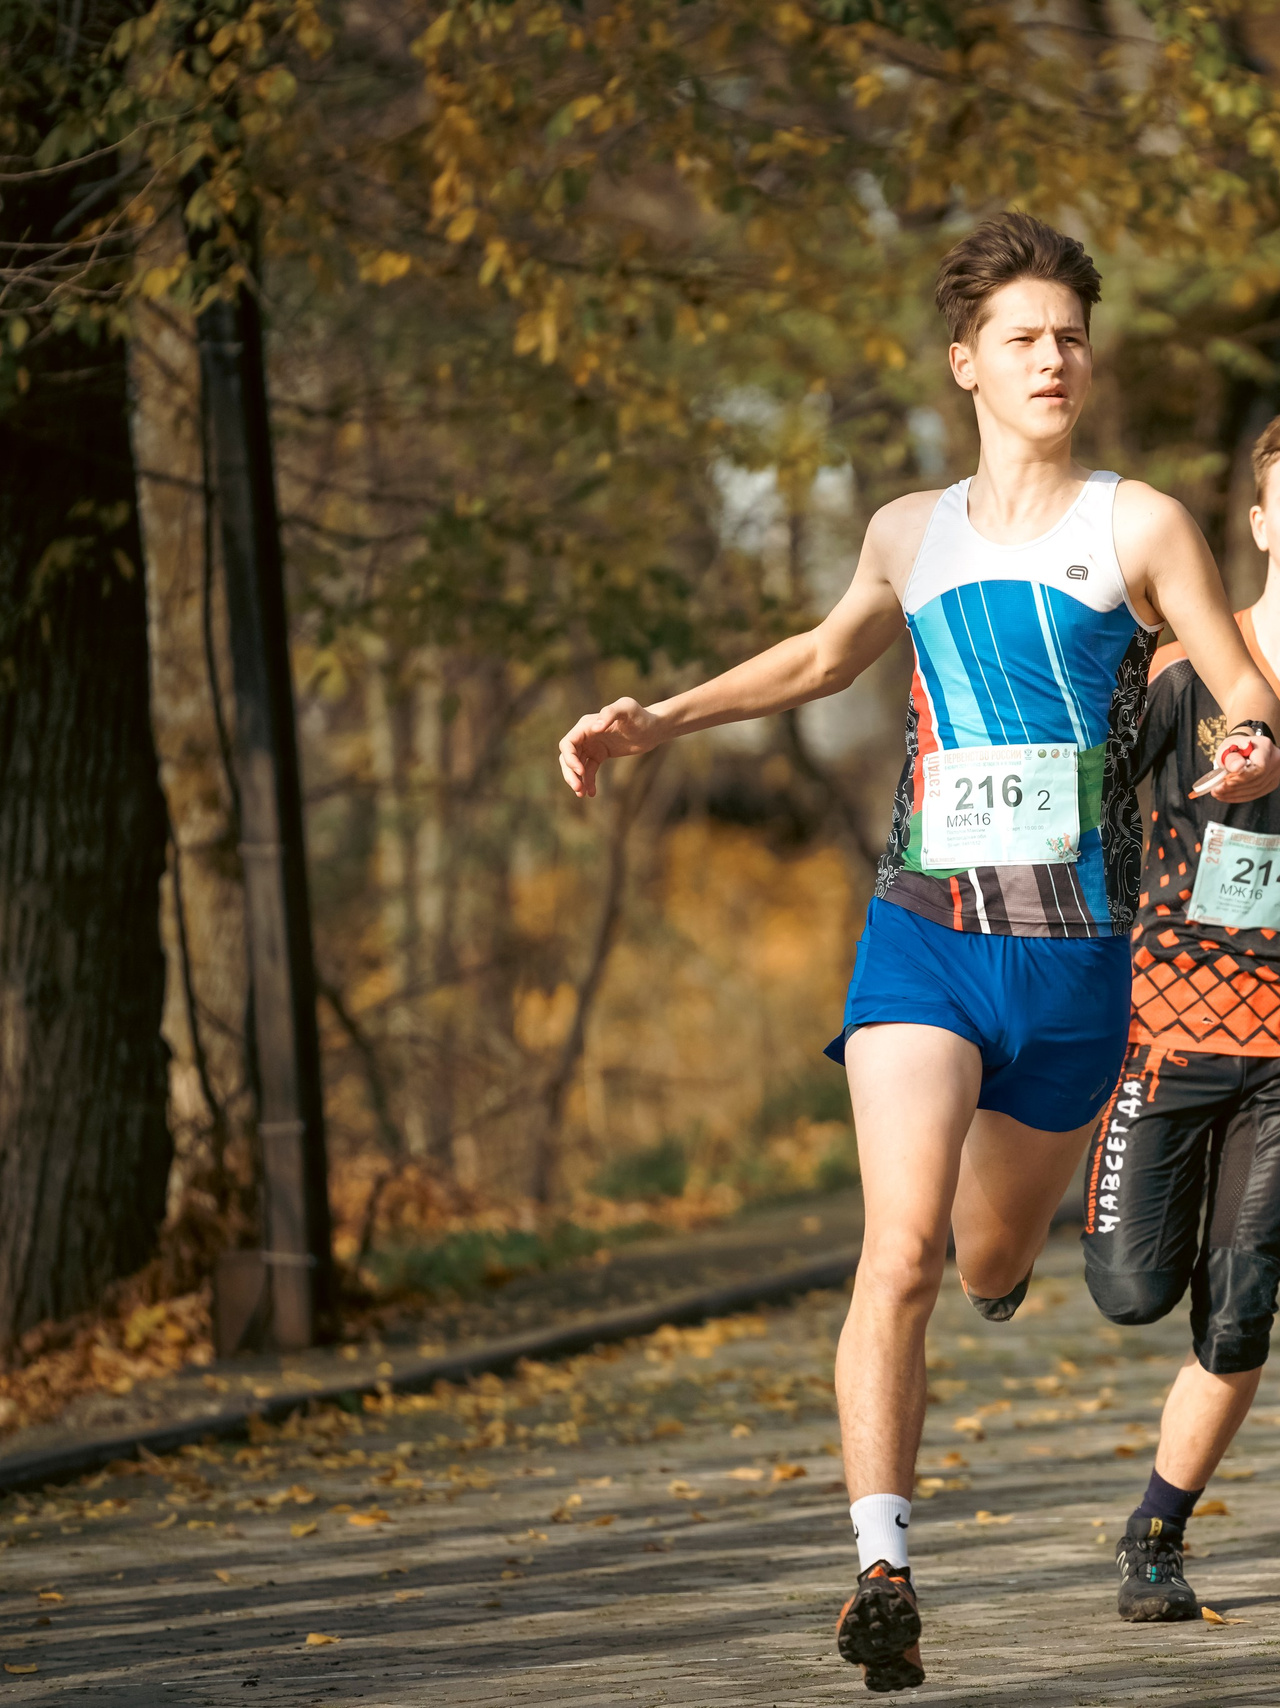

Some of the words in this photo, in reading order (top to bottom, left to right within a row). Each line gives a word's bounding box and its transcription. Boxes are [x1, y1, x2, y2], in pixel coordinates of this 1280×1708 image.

[943, 750, 990, 765] ПЕРВЕНСТВО
[991, 749, 1022, 761] РОССИИ
[928, 754, 941, 788] ЭТАП
[929, 789, 941, 798] 2
[954, 774, 1023, 811] 216
[1037, 789, 1051, 811] 2
[946, 812, 991, 828] МЖ16
[1207, 829, 1226, 854] ЭТАП
[1205, 855, 1220, 865] 2
[1219, 883, 1263, 900] МЖ16
[1098, 1080, 1143, 1234] НАВСЕГДА
